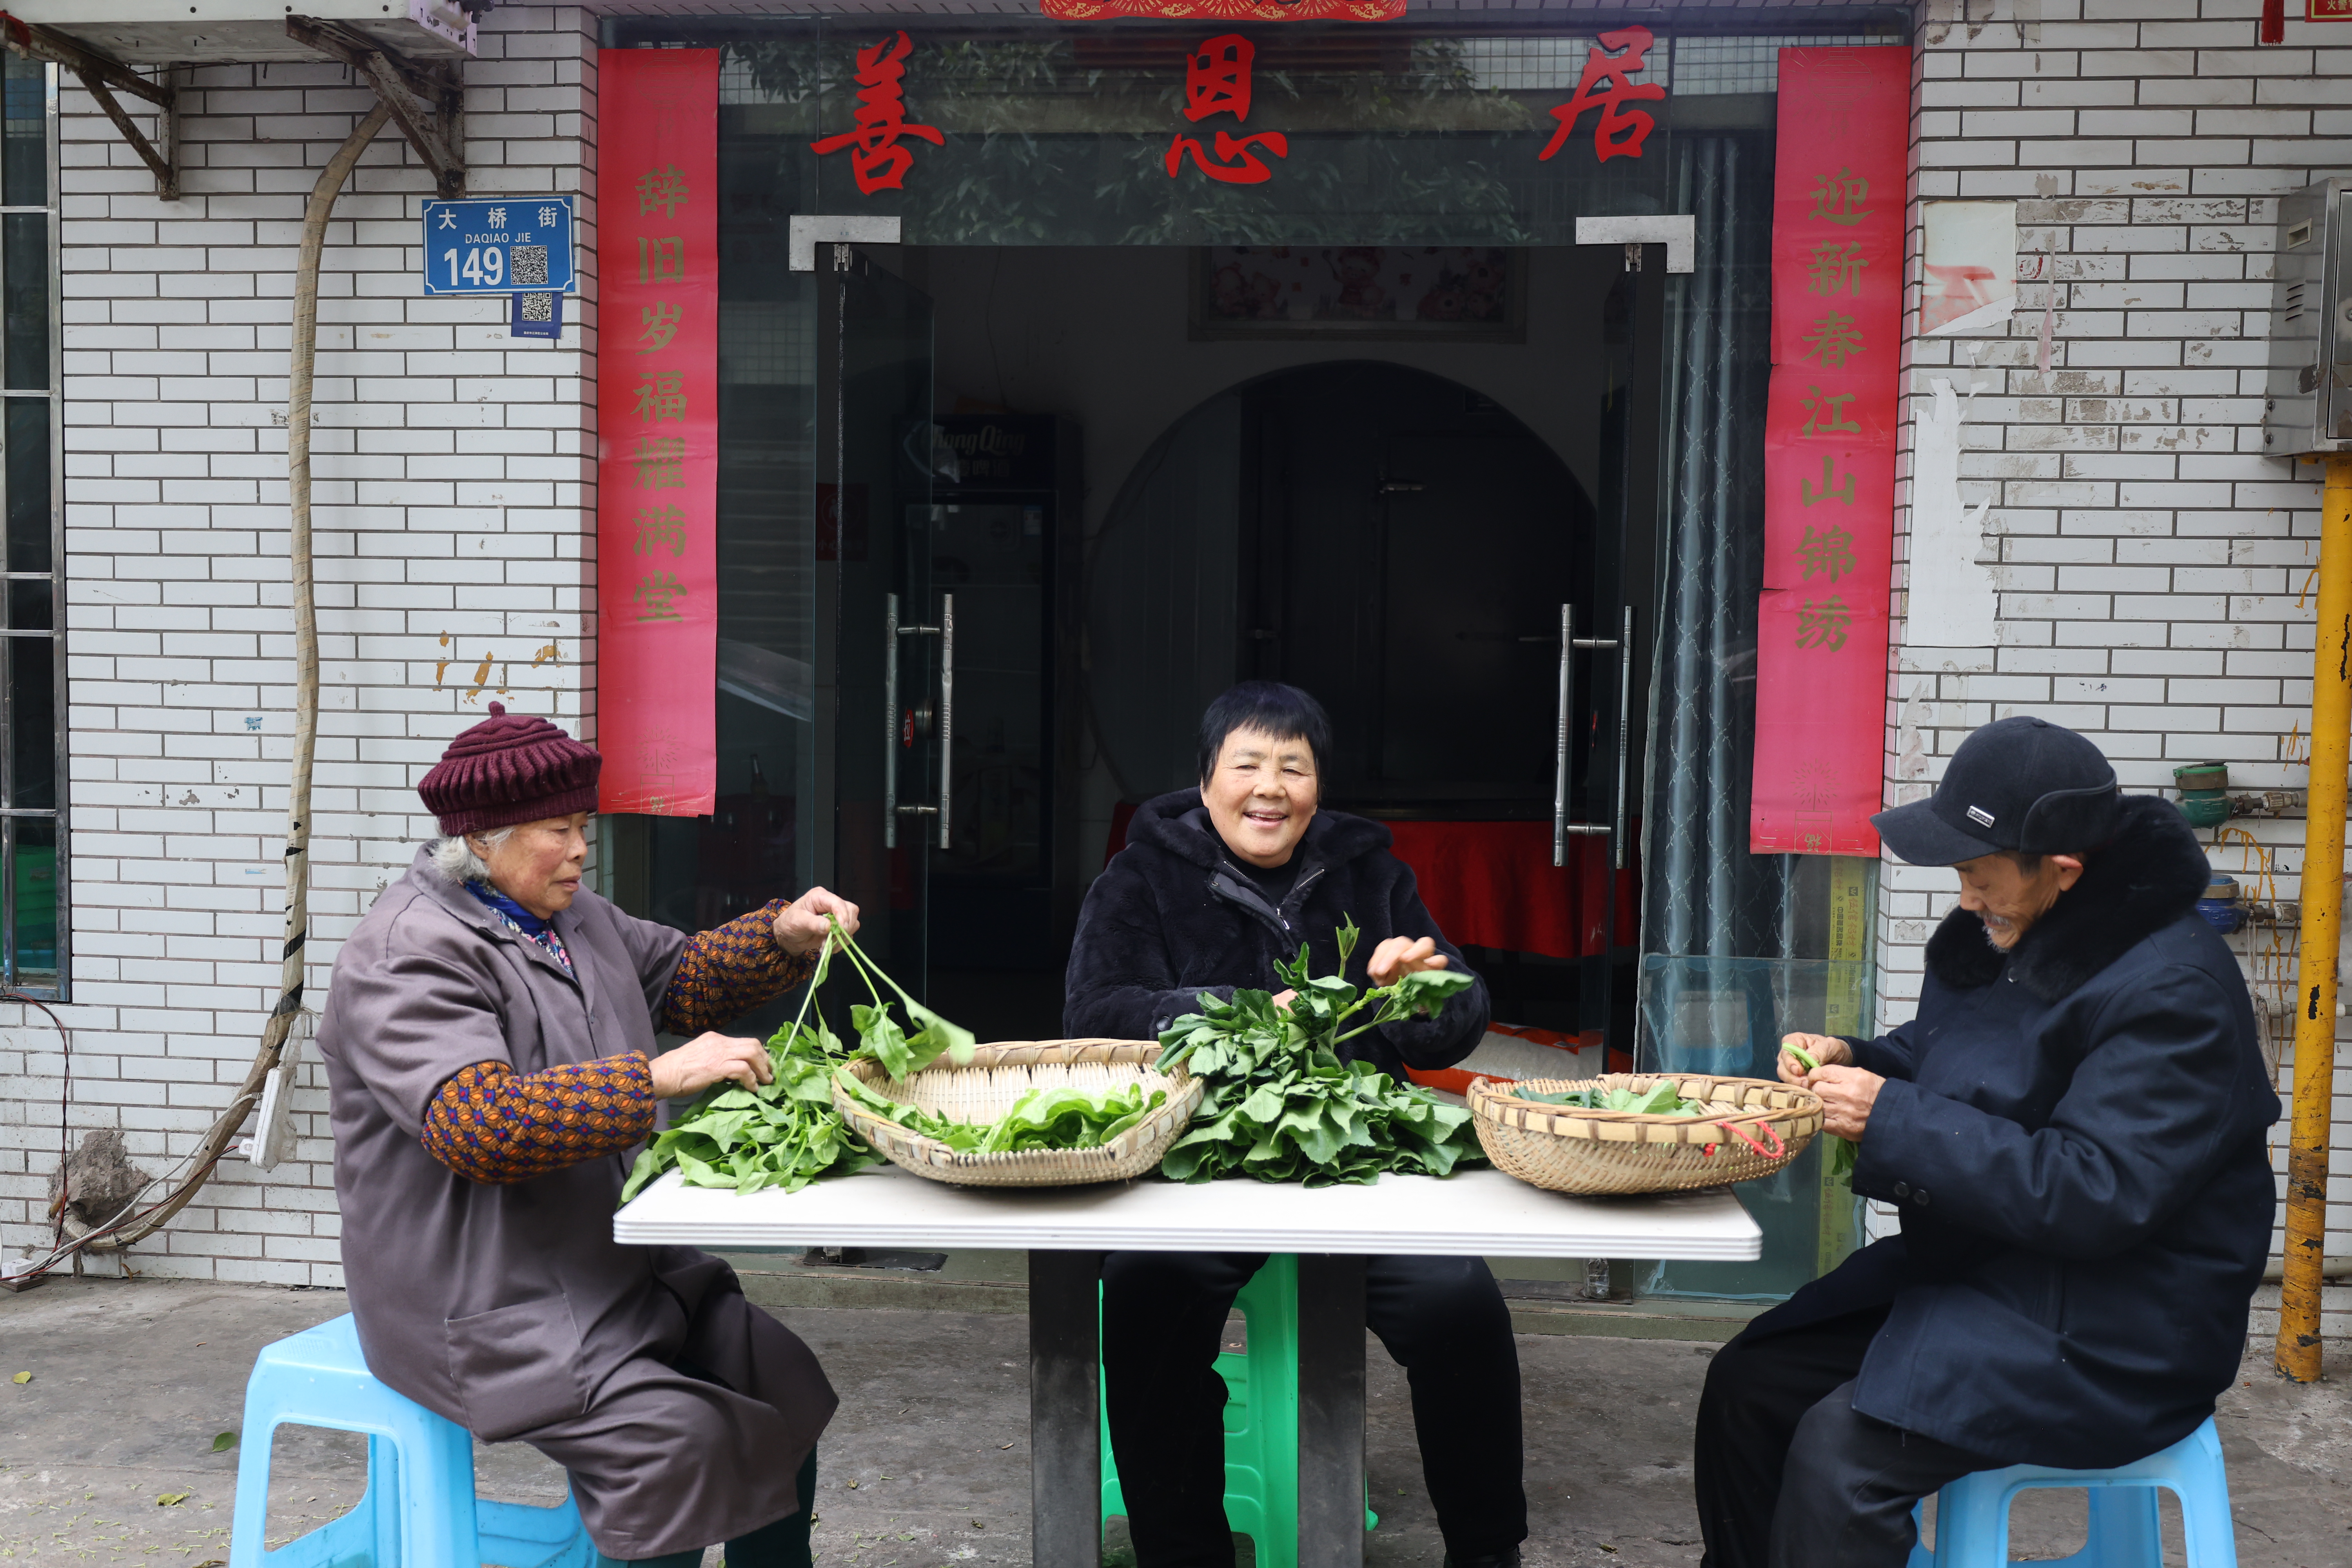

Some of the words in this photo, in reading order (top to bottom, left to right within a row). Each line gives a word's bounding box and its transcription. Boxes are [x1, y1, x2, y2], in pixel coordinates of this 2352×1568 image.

[810, 25, 1666, 196] 善恩居
[438, 207, 557, 230] 大桥街
[465, 233, 509, 244] DAQIAO
[515, 232, 531, 243] JIE
[444, 246, 504, 286] 149
[630, 163, 690, 623] 辞旧岁福耀满堂
[1791, 166, 1875, 653] 迎新春江山锦绣
[1836, 906, 1844, 946] 中国著名品牌
